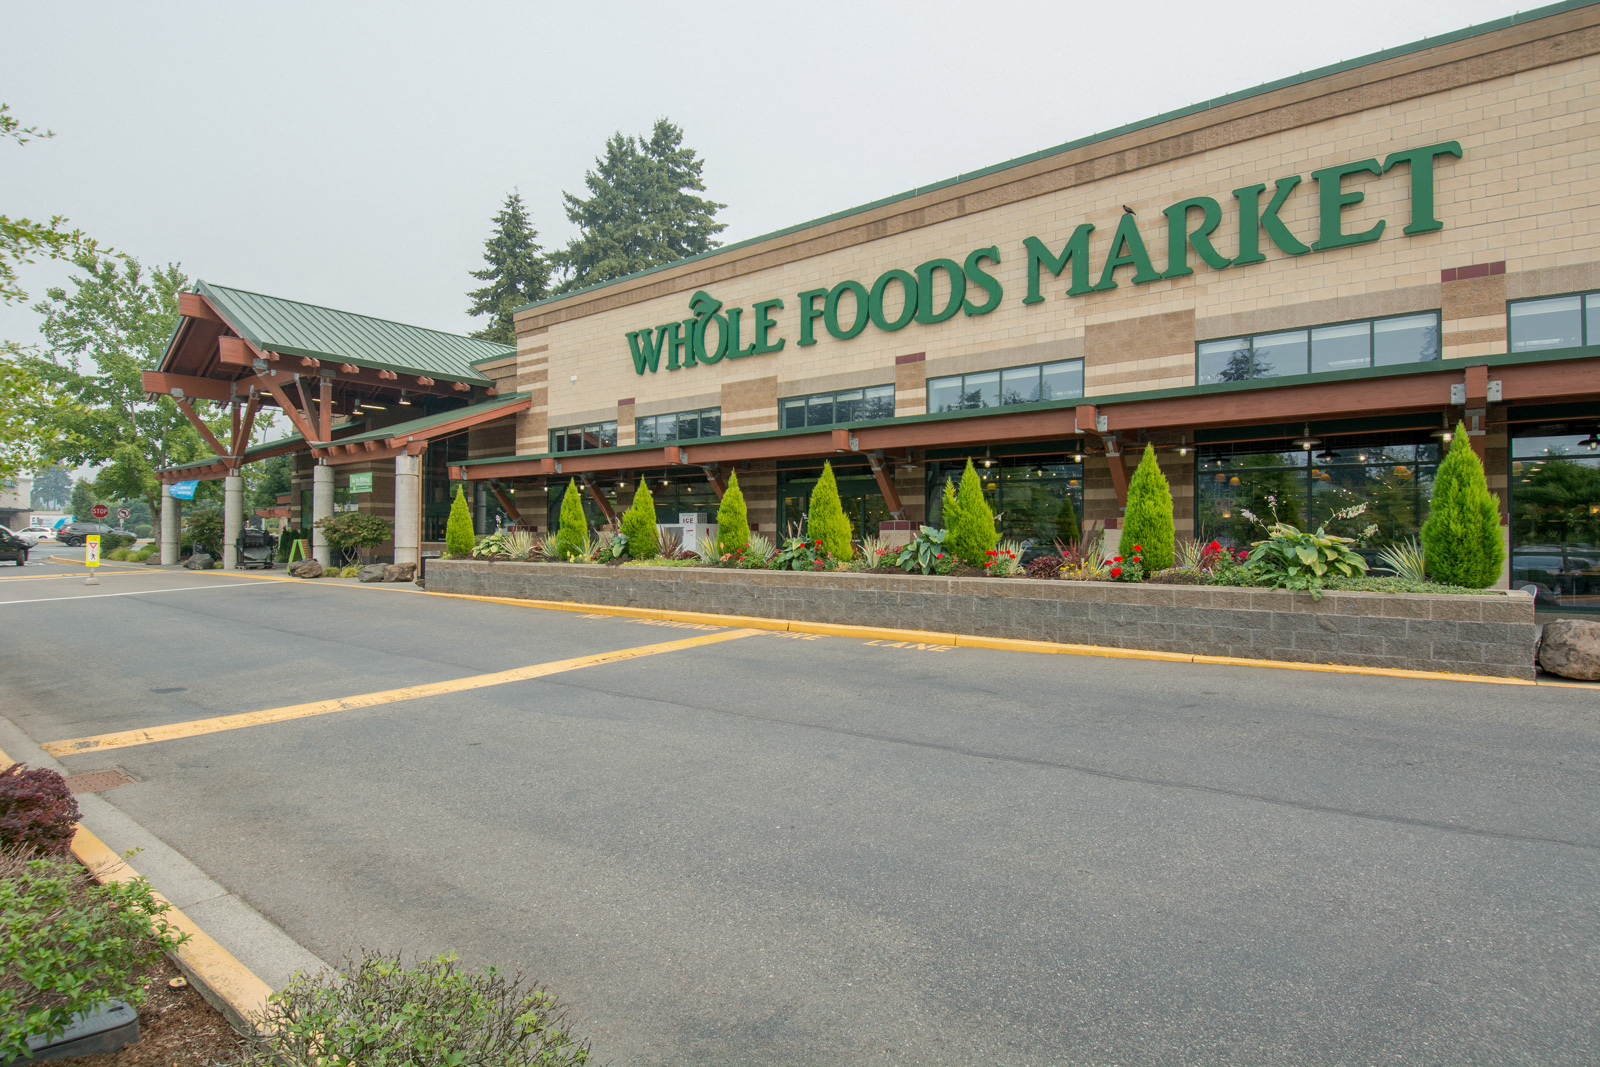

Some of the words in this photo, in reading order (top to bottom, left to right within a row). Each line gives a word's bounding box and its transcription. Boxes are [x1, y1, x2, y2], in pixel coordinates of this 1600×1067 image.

[626, 291, 786, 374] WHOLE
[797, 247, 1002, 346] FOODS
[1022, 141, 1463, 303] MARKET
[624, 618, 729, 631] PARKING
[760, 631, 831, 640] FIRE
[862, 639, 959, 652] LANE
